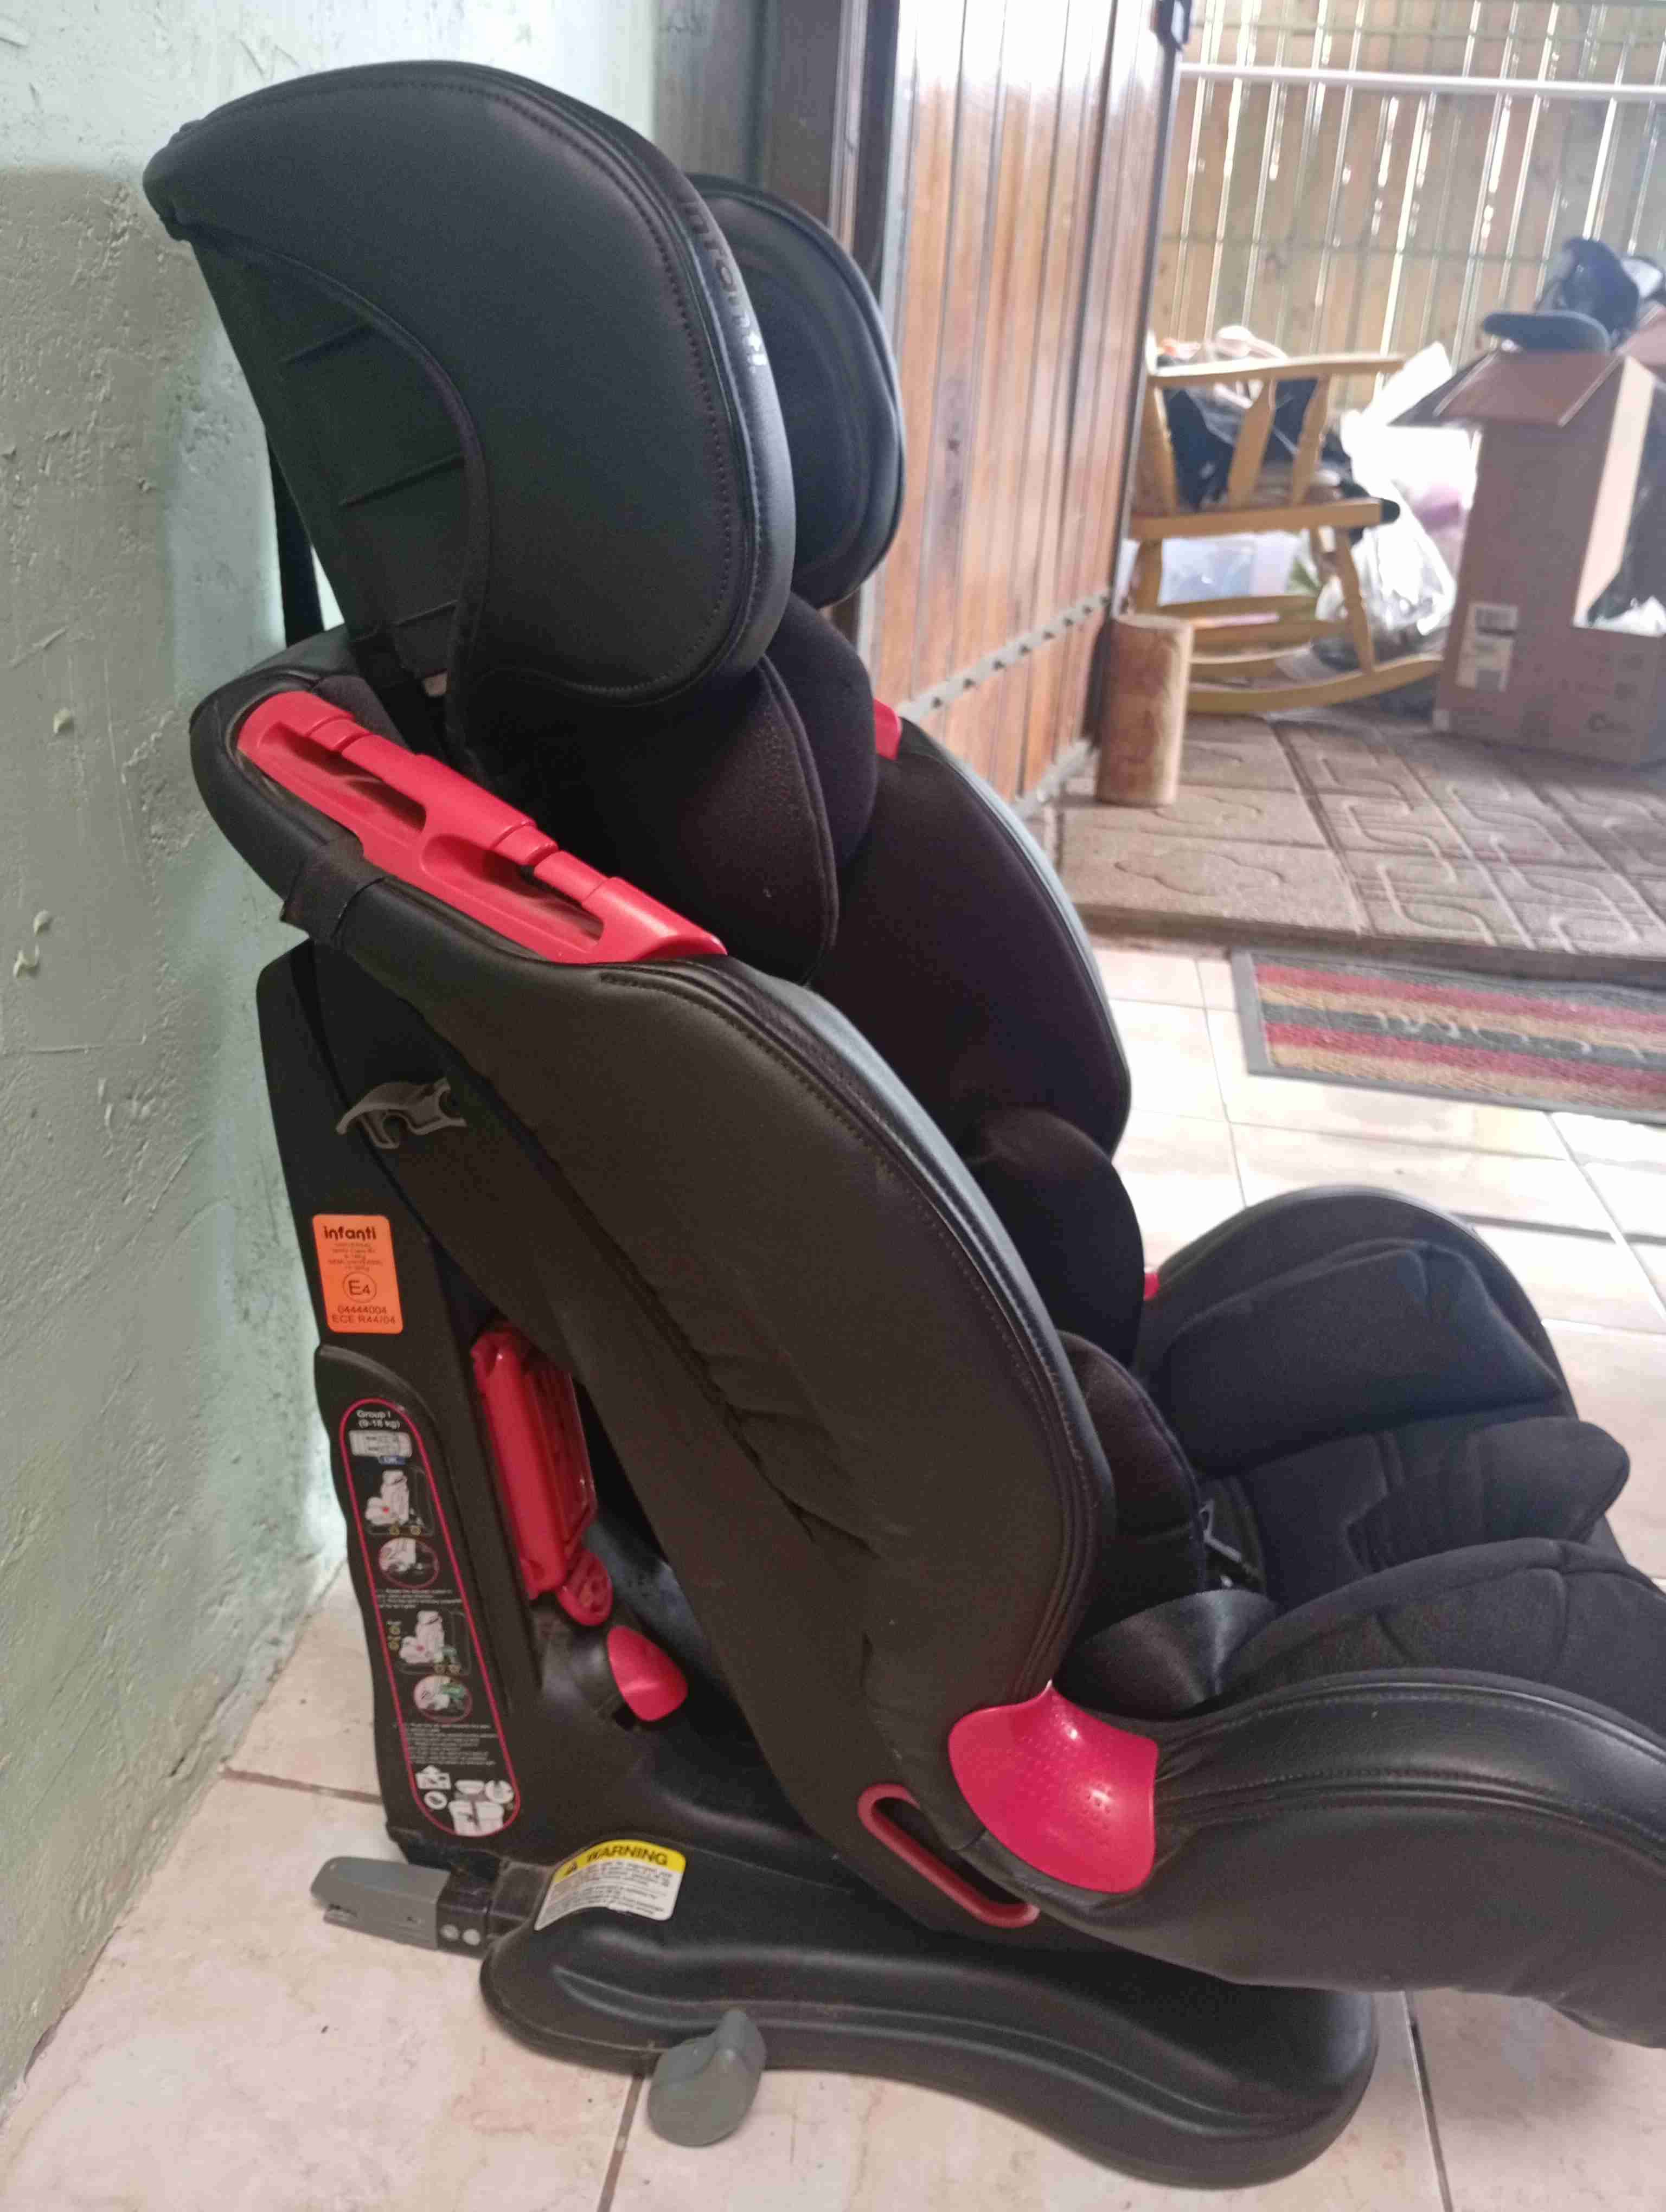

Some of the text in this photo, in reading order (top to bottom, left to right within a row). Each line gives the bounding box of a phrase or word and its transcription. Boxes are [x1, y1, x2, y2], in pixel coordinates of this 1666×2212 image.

[323, 1226, 377, 1240] infanti
[348, 1280, 370, 1295] E4
[331, 1314, 354, 1323] ECE
[356, 1410, 386, 1420] Group
[586, 1845, 668, 1866] WARNING
